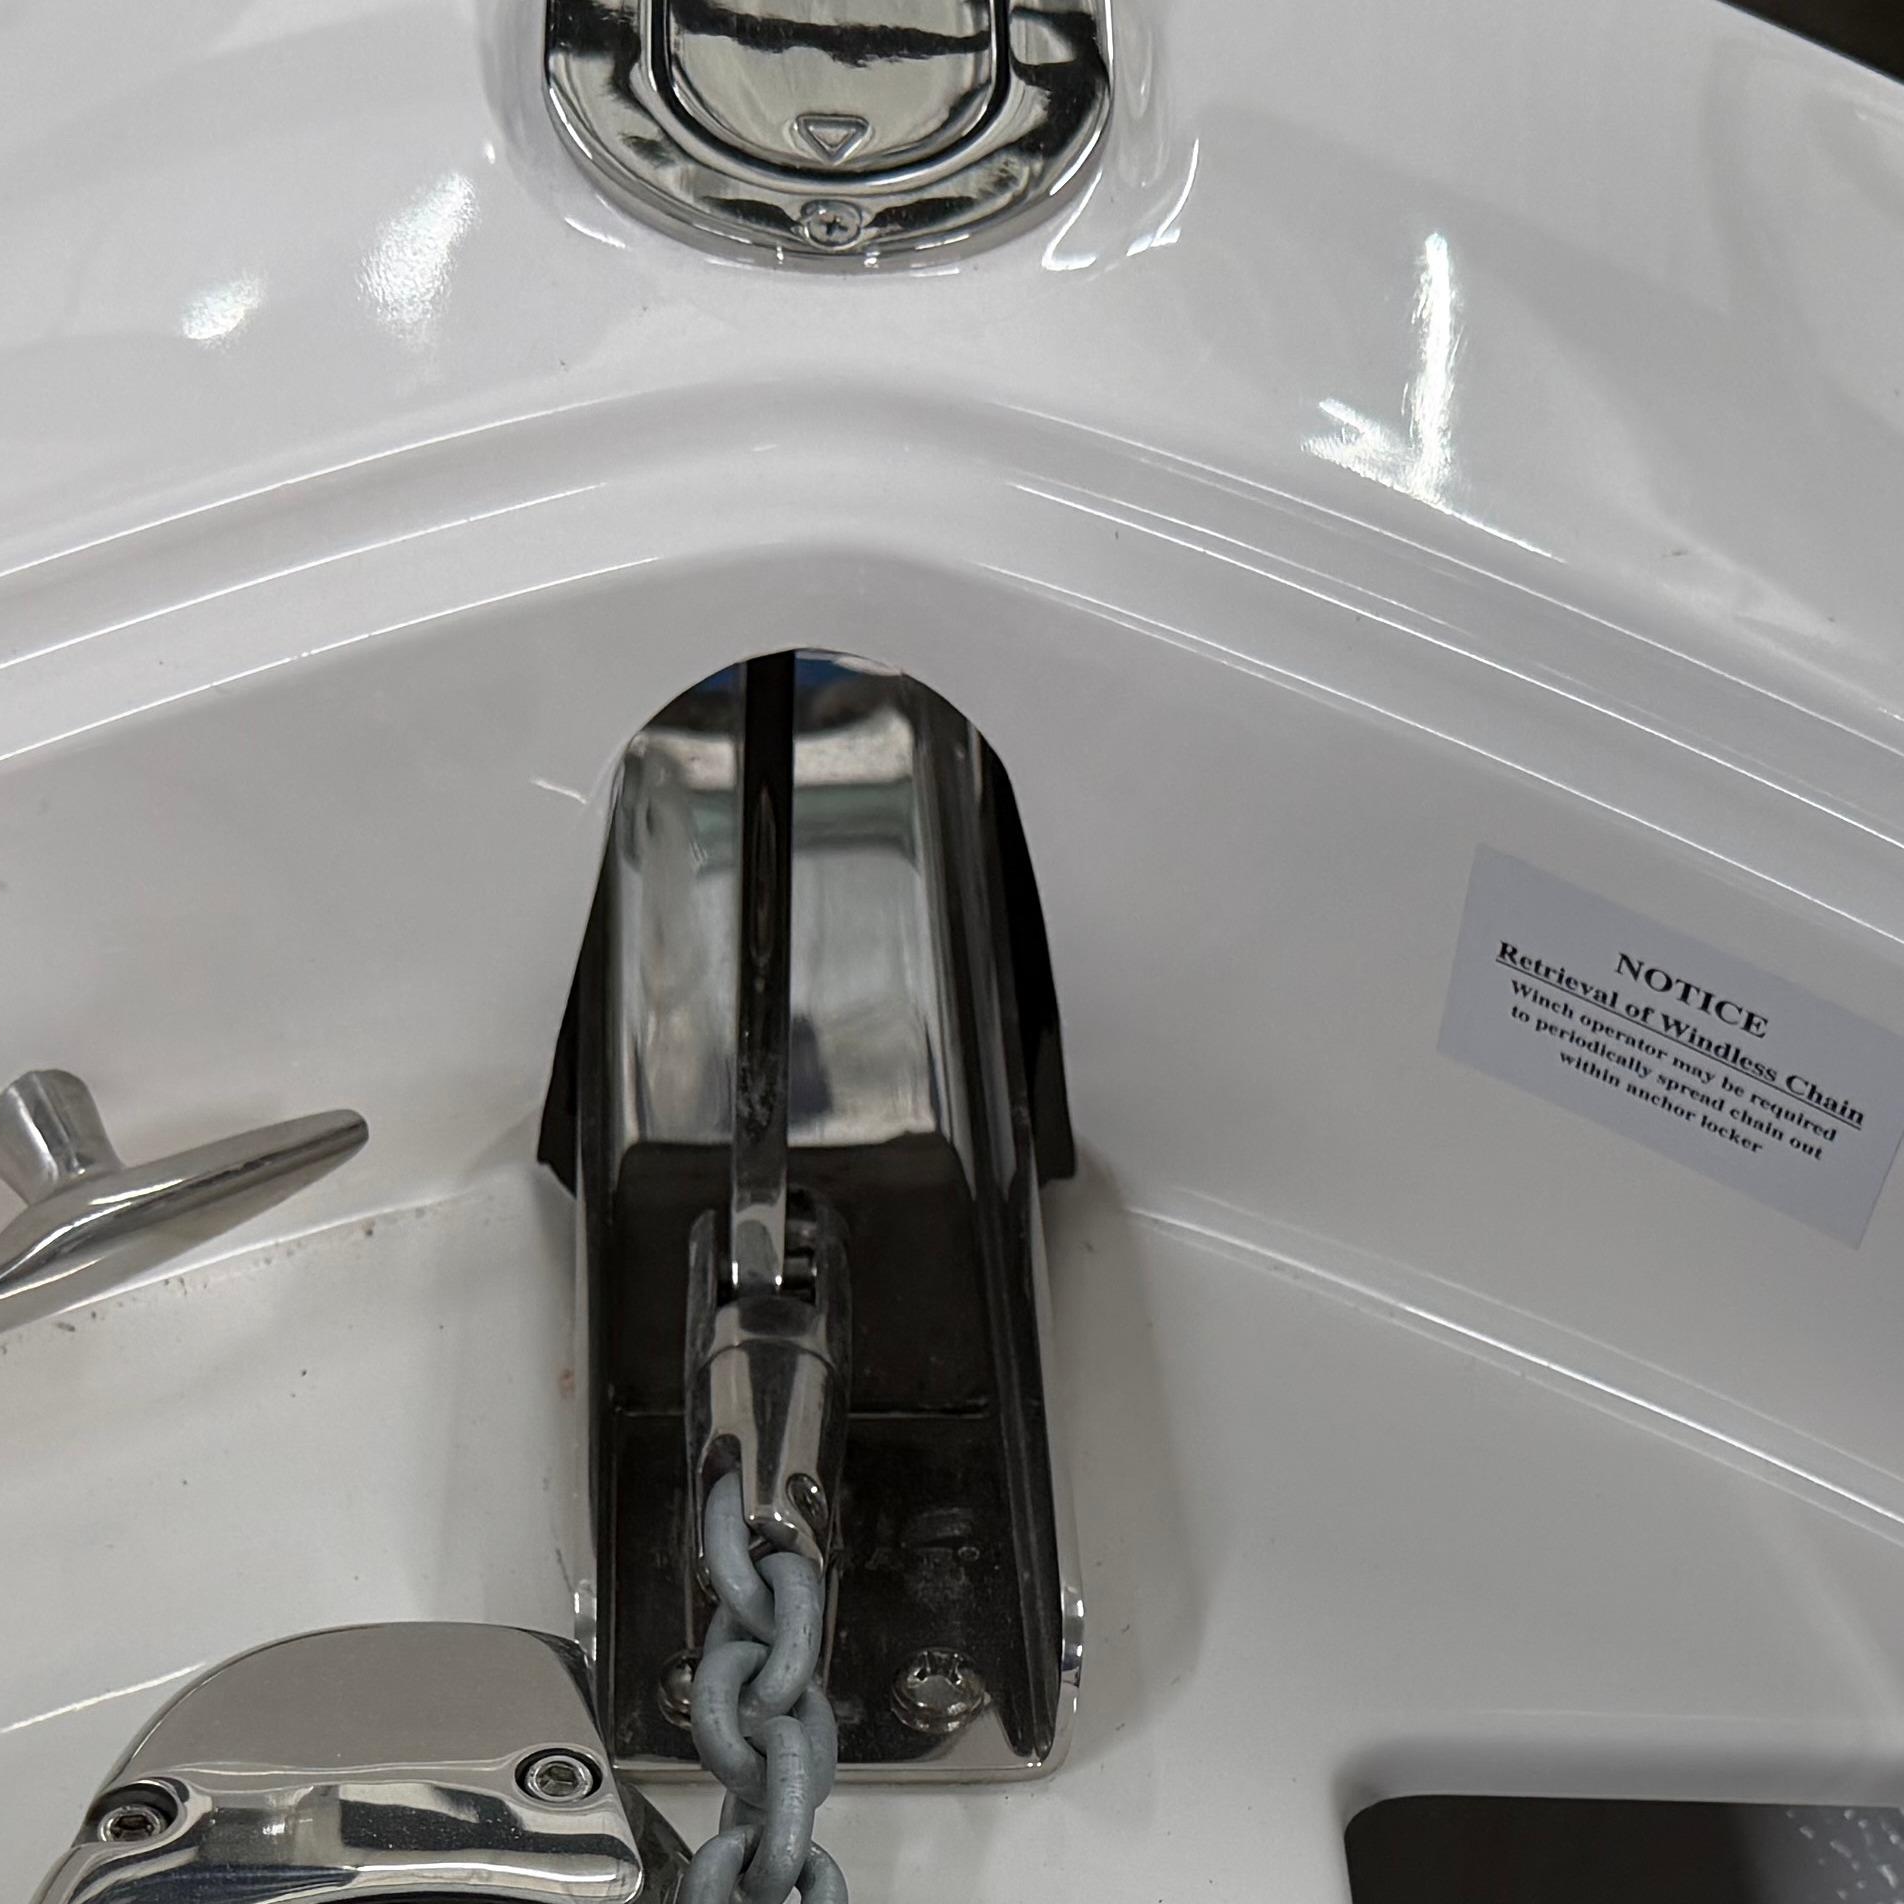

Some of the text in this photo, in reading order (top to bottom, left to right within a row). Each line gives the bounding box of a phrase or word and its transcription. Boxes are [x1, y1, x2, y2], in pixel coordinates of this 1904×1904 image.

[1498, 941, 1864, 1126] Retrieval of Windless Chain
[1511, 979, 1837, 1142] Winch operator may be required
[1616, 953, 1769, 1039] NOTICE
[1511, 1005, 1823, 1160] to periodically spread chain out
[1560, 1052, 1763, 1153] within anchor locker
